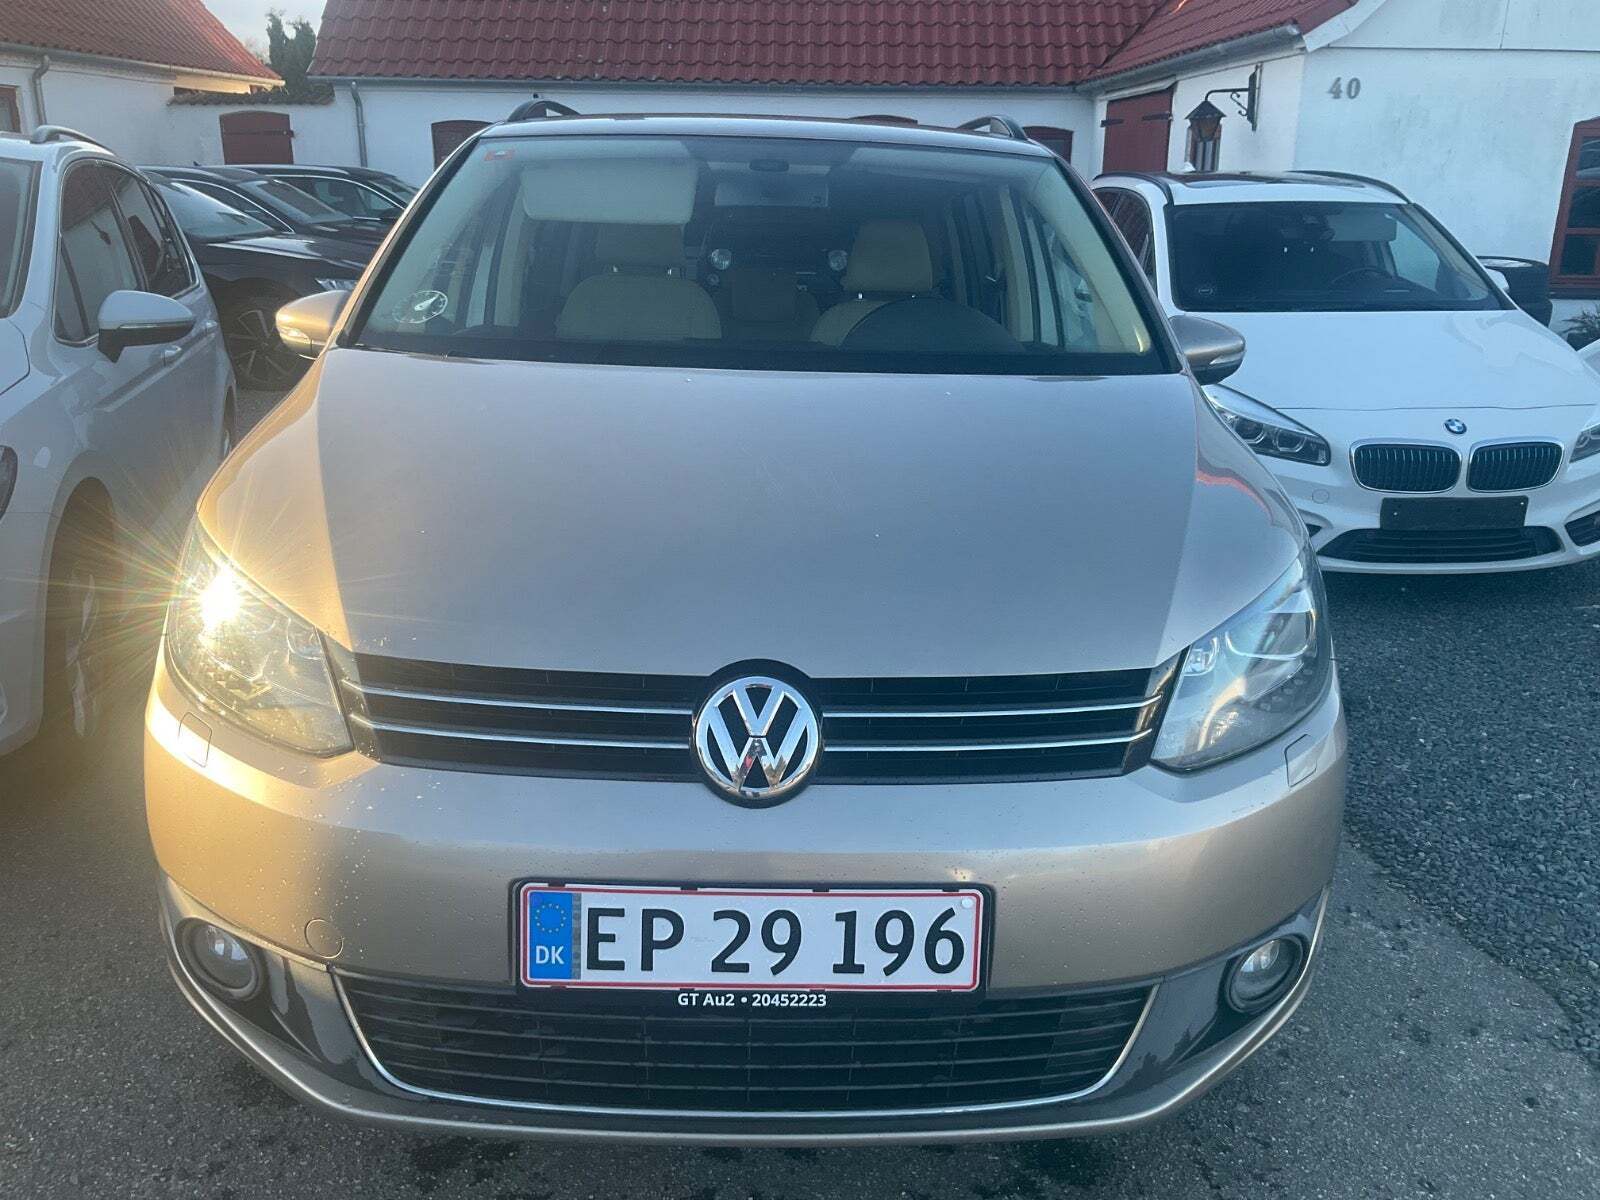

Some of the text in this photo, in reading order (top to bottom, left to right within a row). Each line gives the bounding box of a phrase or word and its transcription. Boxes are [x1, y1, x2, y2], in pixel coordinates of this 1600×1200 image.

[1327, 77, 1361, 99] 40
[586, 907, 965, 977] EP 29 196
[535, 945, 564, 966] DK
[677, 993, 827, 1007] GT Au2 20452223
